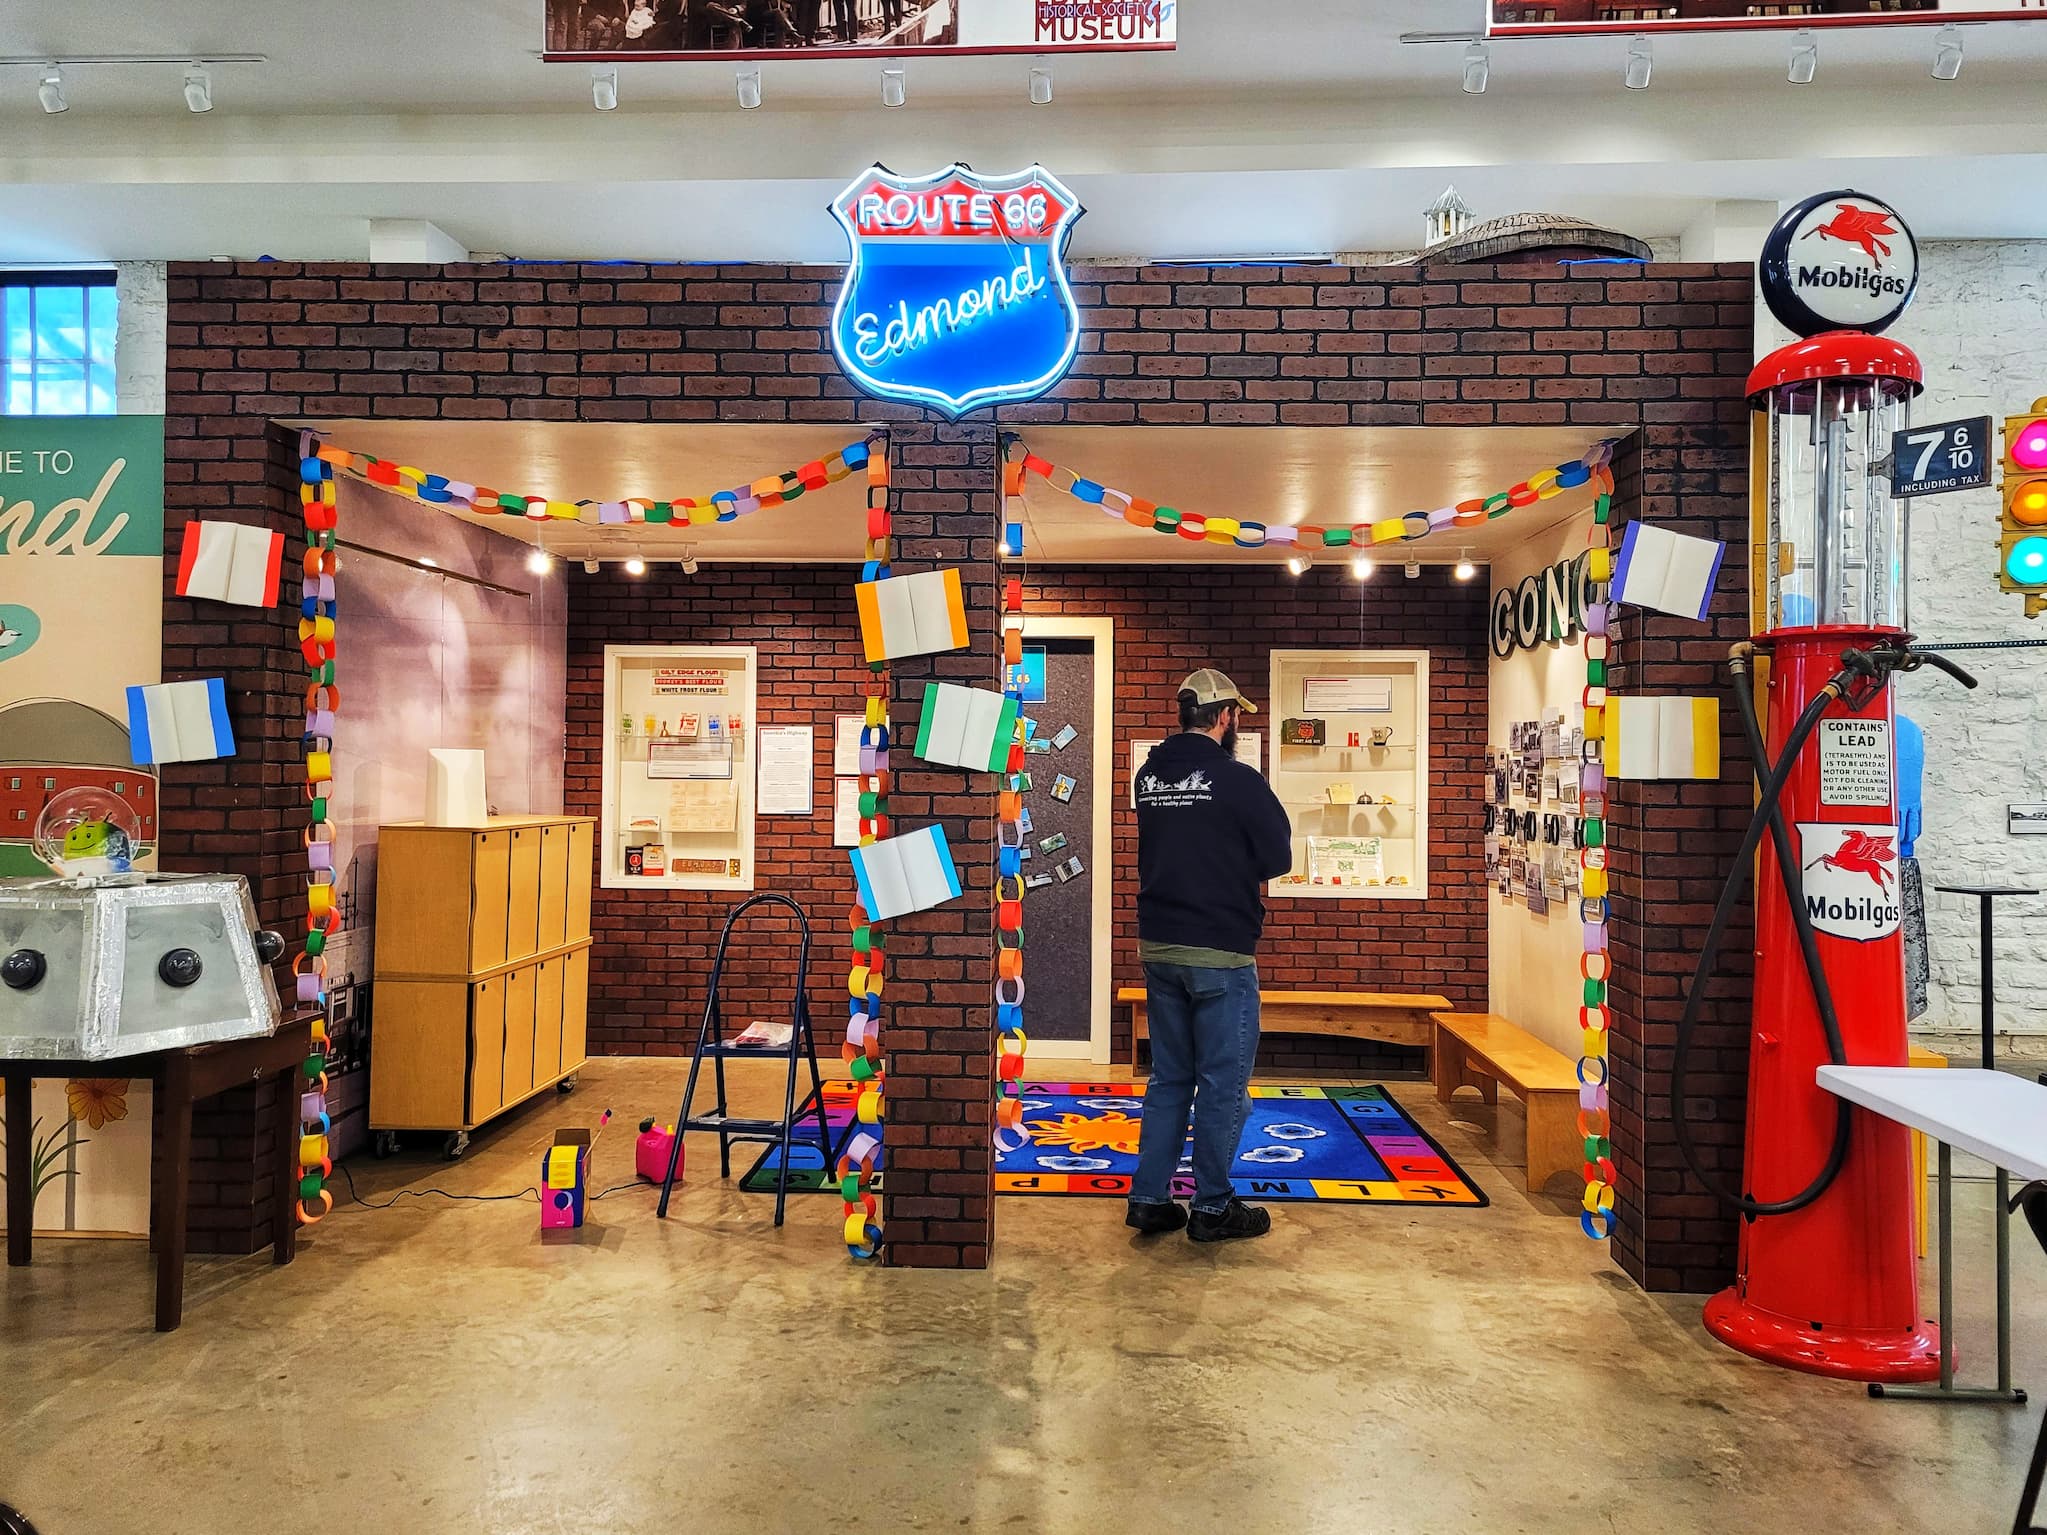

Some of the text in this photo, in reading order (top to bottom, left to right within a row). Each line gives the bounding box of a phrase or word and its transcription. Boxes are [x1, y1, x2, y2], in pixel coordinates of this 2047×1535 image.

[1038, 4, 1097, 18] HISTORICAL
[1101, 2, 1148, 17] SOCIETY
[1034, 11, 1161, 41] MUSEUM
[858, 193, 1048, 225] ROUTE 66
[1797, 265, 1905, 298] Mobilgas
[854, 246, 1045, 361] Edmond
[0, 450, 74, 474] E TO
[1906, 427, 1969, 482] 7 6
[1948, 451, 1974, 470] 10
[1900, 474, 1980, 493] INCLUDING TAX
[1828, 722, 1883, 732] CONTAINS
[1839, 735, 1876, 746] LEAD
[1824, 752, 1872, 760] (TETRAETHYL)
[1807, 895, 1899, 928] Mobilgas
